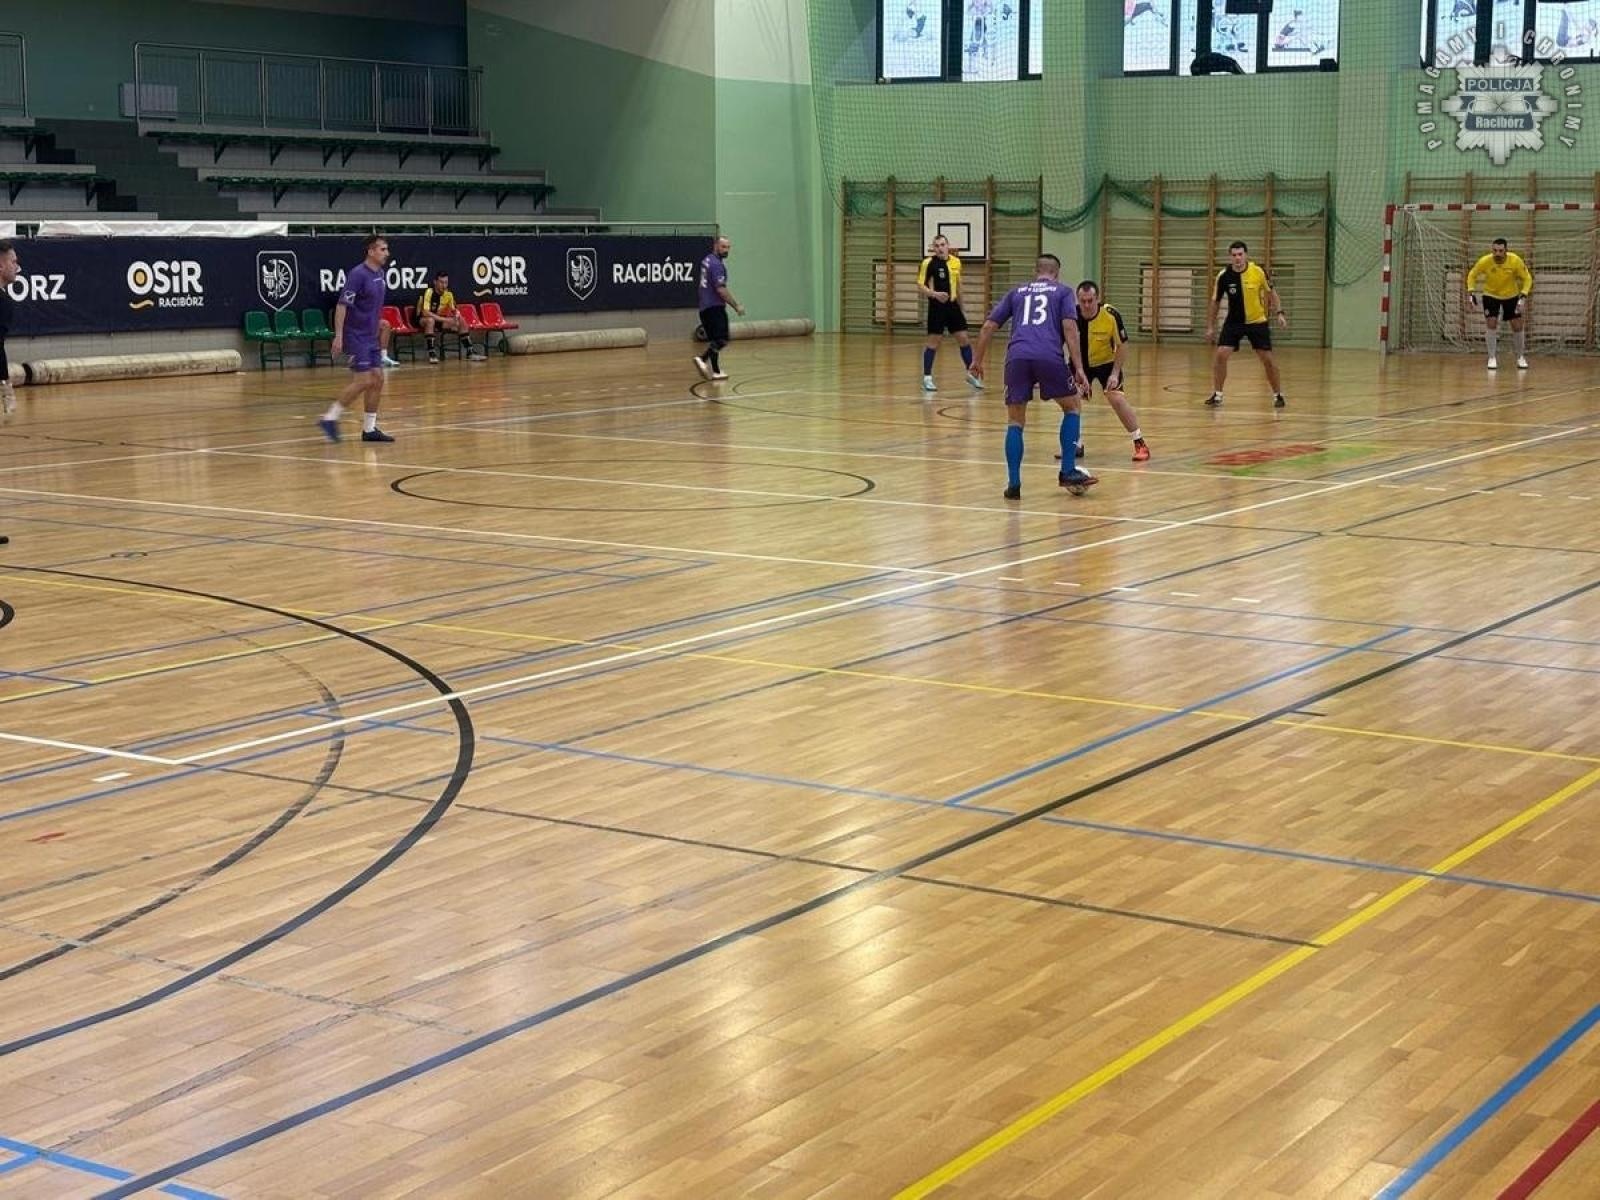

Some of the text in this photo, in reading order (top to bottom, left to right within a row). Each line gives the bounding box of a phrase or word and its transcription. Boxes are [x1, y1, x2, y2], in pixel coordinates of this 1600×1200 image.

[320, 260, 428, 292] RAÓRZ
[612, 256, 693, 283] RACIBÓRZ
[158, 294, 204, 307] RACIBÓRZ
[1022, 294, 1048, 325] 13
